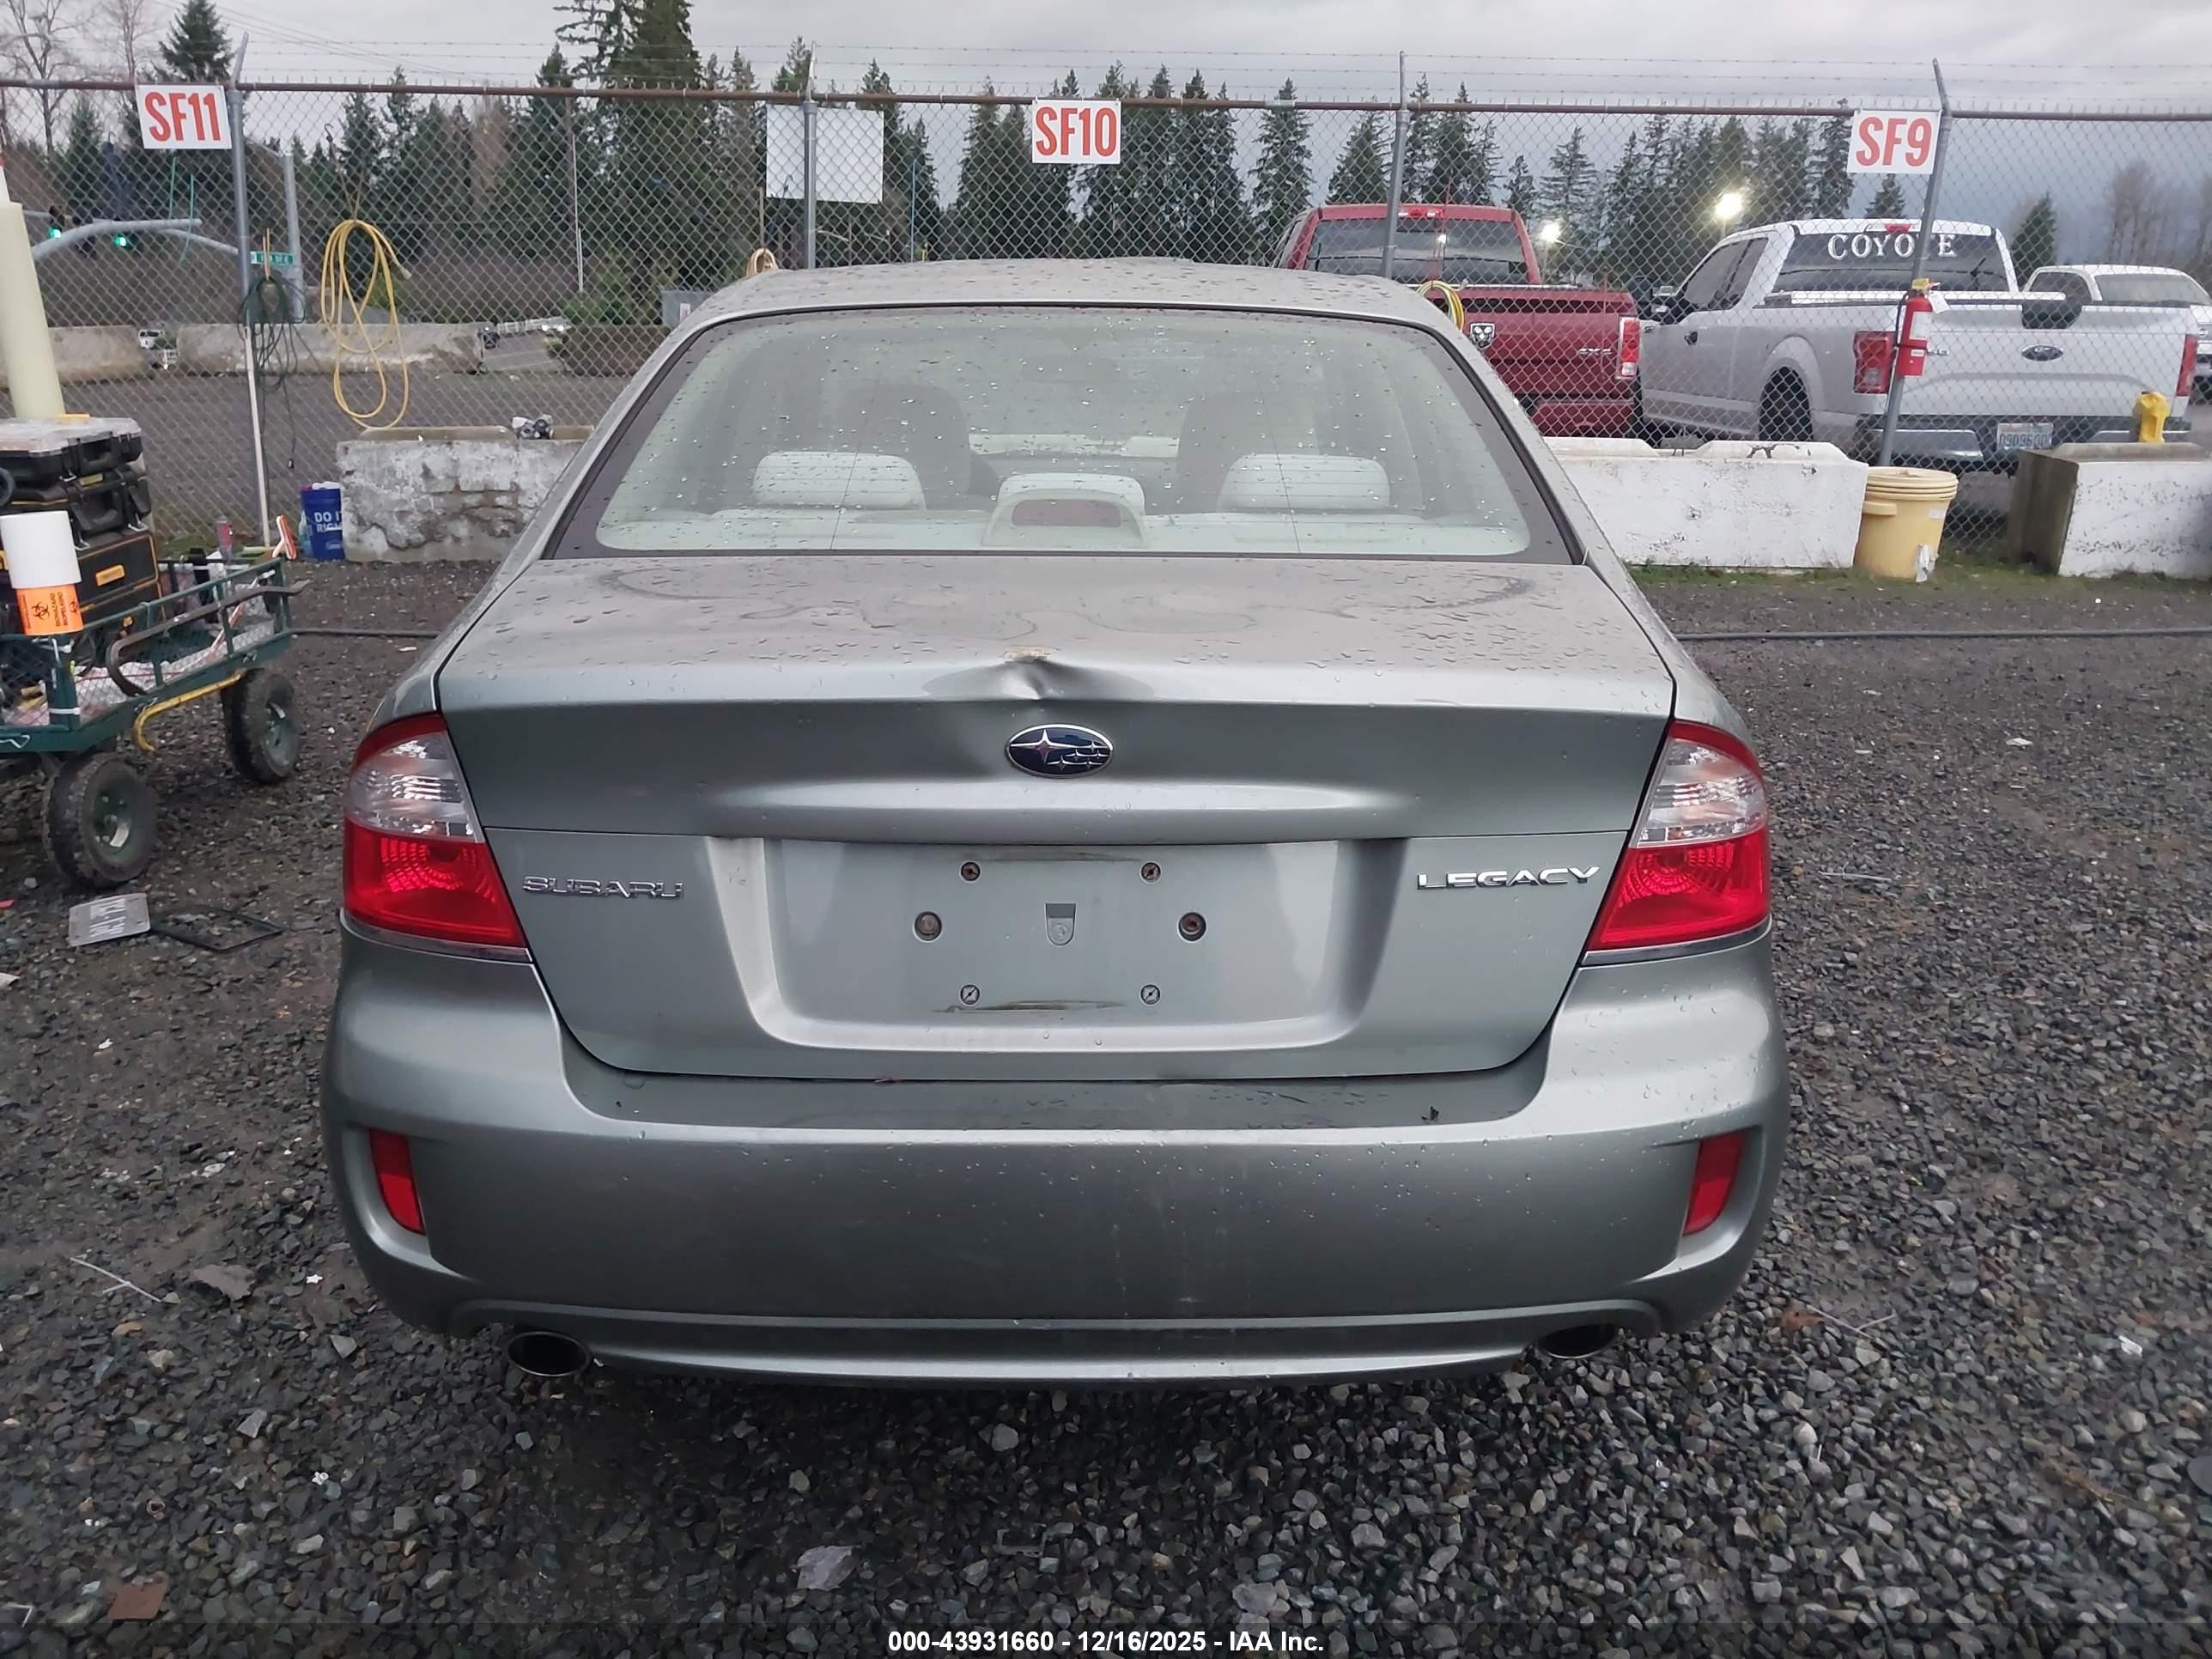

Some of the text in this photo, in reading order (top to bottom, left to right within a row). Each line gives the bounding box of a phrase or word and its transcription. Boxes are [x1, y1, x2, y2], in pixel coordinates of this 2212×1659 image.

[143, 91, 221, 142] SF11
[1036, 106, 1117, 157] SF10
[1856, 116, 1932, 167] SF9
[1827, 233, 1957, 260] COYOE
[314, 511, 332, 523] DO
[522, 874, 684, 899] SUBARU
[1417, 866, 1600, 890] LEGACY
